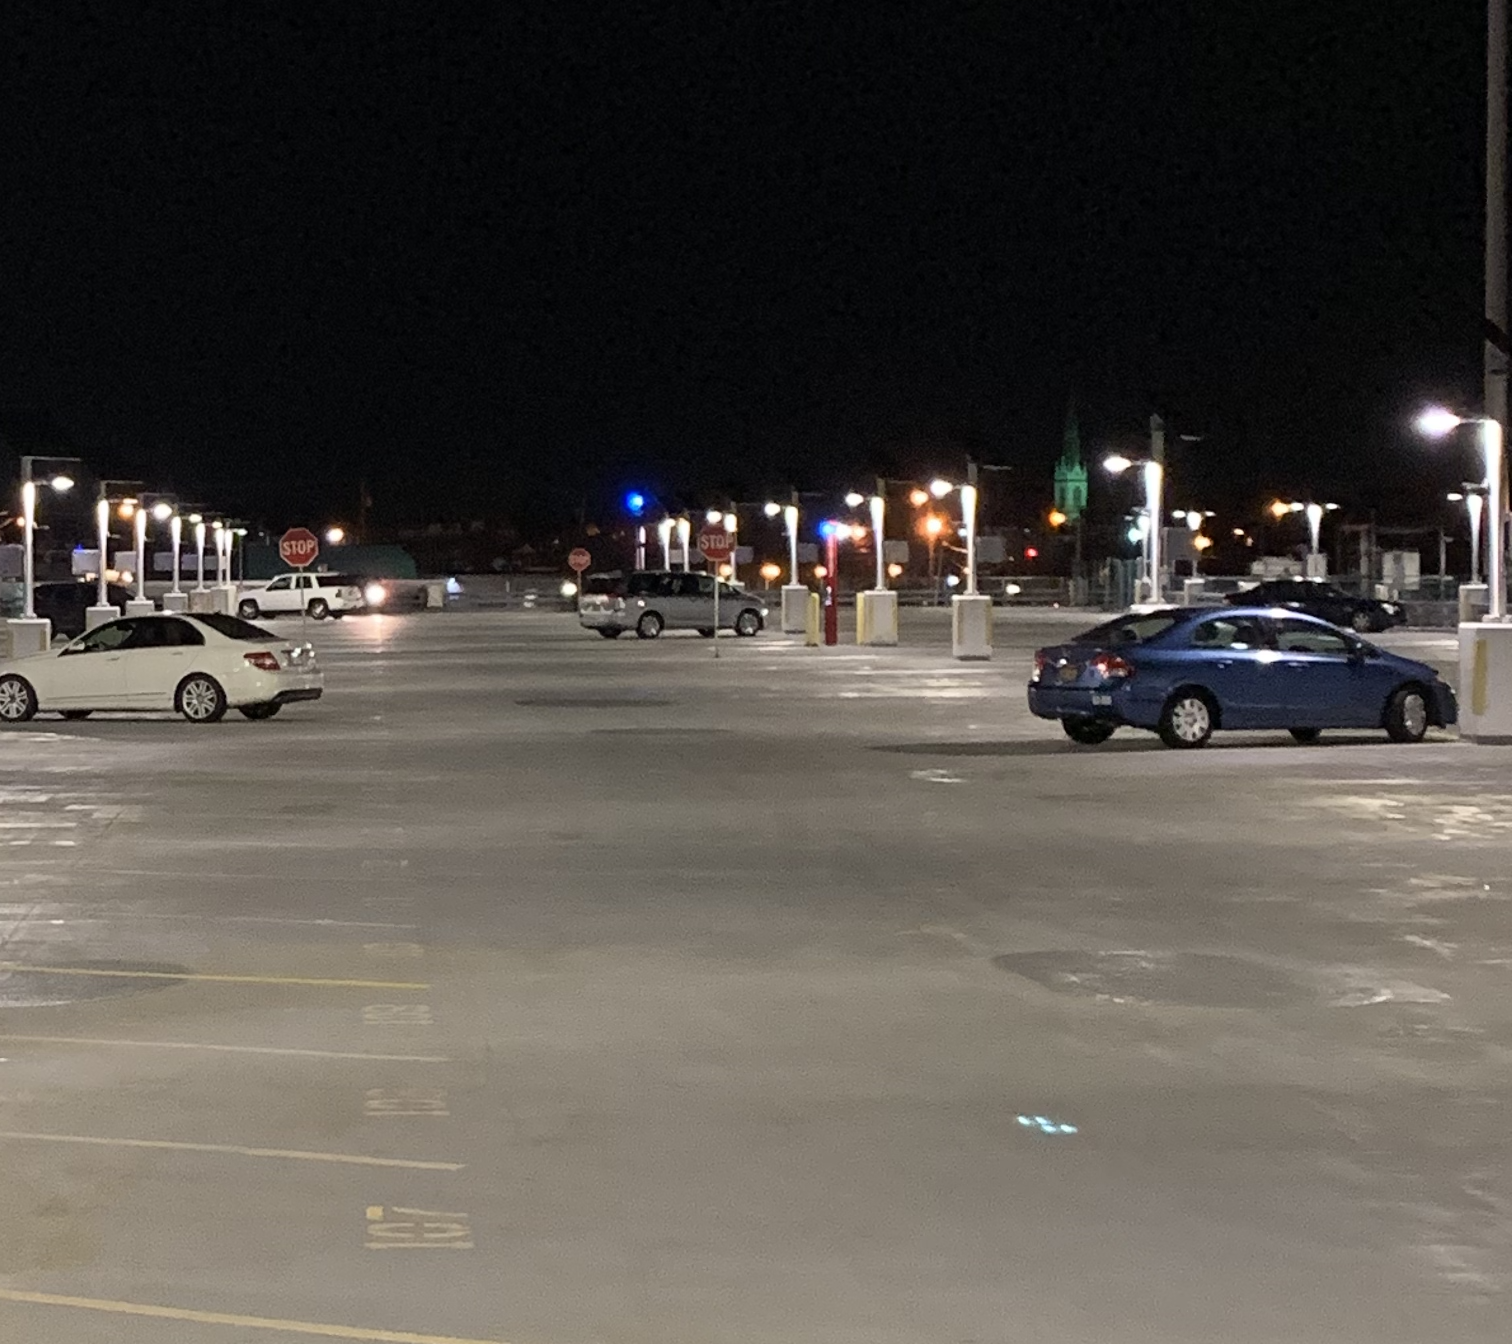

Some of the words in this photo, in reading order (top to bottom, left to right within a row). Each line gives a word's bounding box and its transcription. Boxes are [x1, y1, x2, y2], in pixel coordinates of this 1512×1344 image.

[283, 540, 315, 555] STOP
[700, 534, 734, 549] STOP
[364, 1205, 475, 1250] 107
